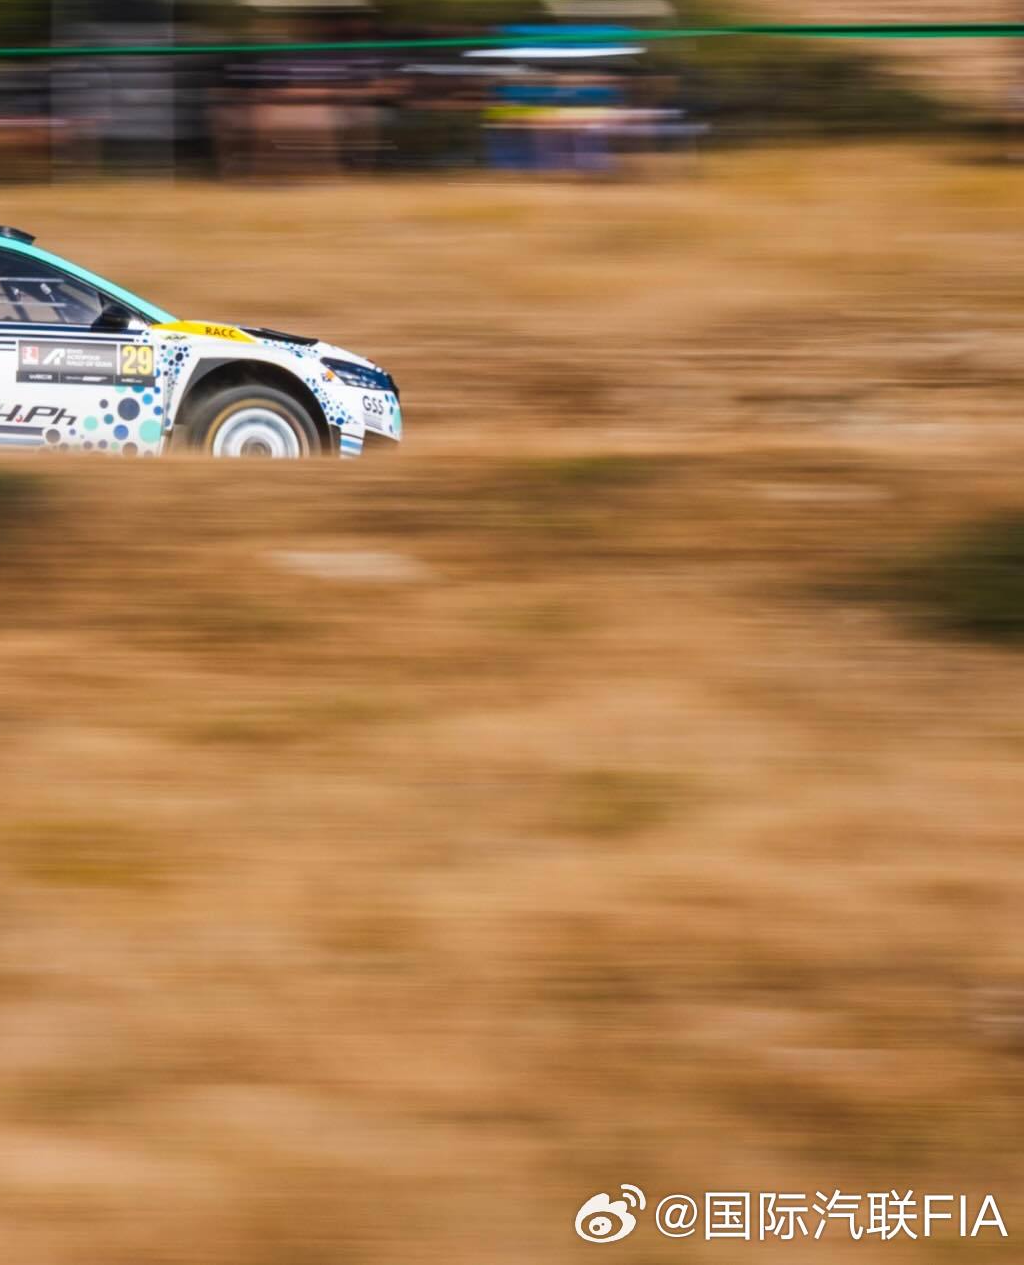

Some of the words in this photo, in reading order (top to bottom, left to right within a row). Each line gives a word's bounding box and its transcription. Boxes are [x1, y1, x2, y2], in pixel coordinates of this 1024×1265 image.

[205, 326, 236, 338] RACC
[121, 345, 154, 376] 29
[362, 394, 385, 416] GSS
